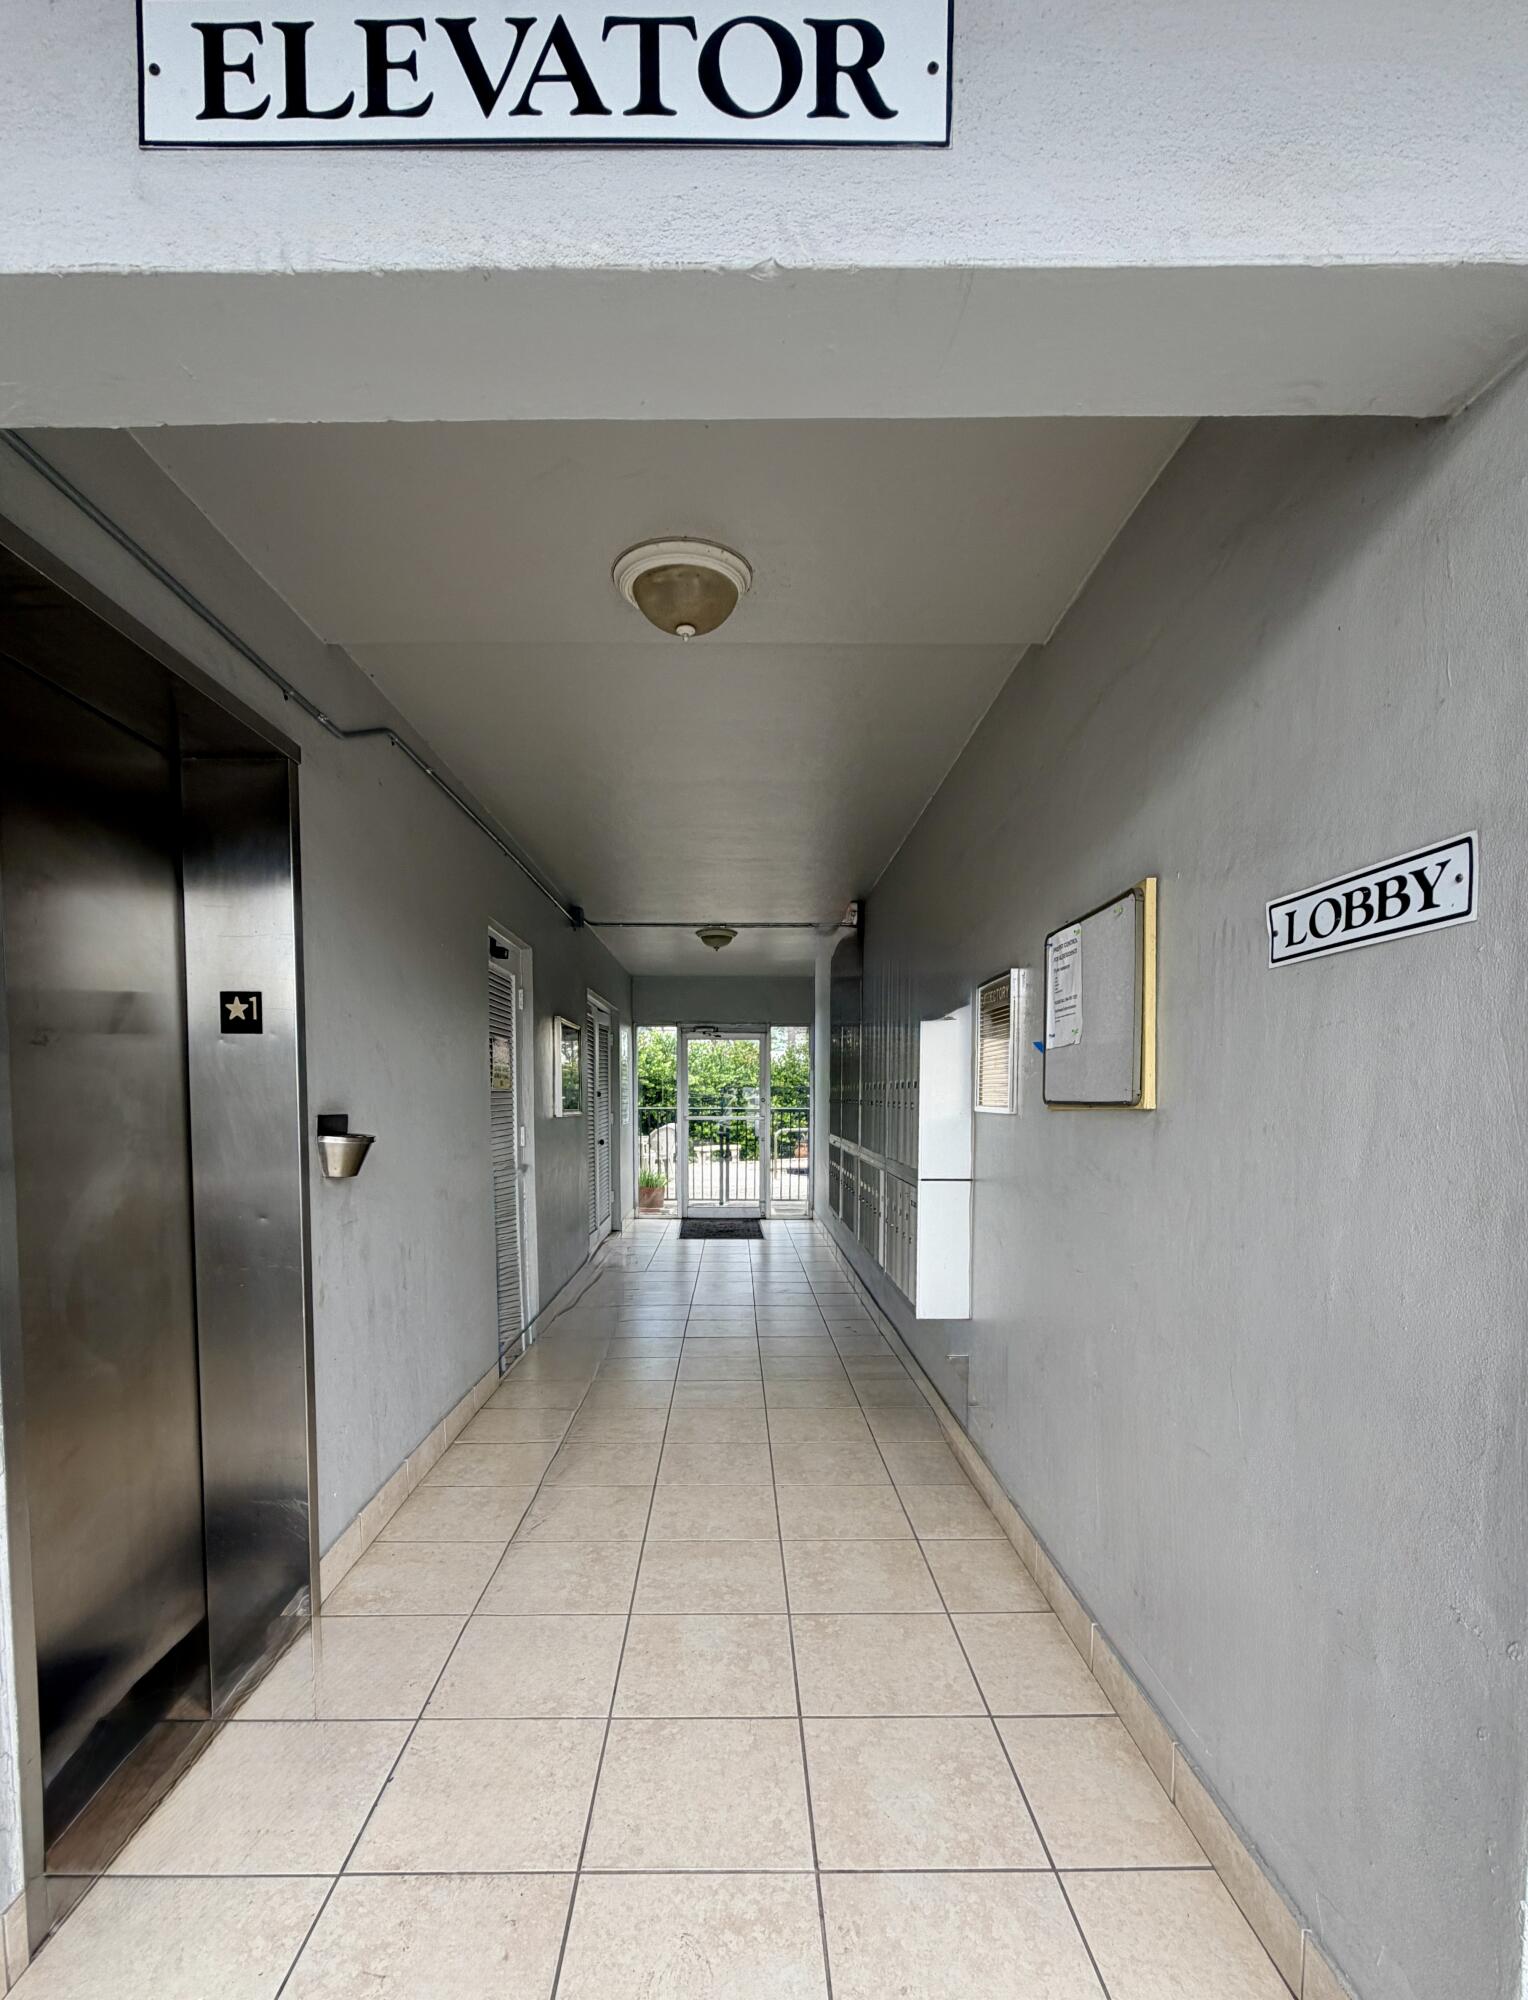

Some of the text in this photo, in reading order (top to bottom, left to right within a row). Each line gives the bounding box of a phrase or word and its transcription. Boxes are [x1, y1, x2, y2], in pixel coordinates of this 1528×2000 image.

[190, 14, 899, 120] ELEVATOR
[1285, 859, 1452, 948] LOBBY
[249, 996, 257, 1020] 1
